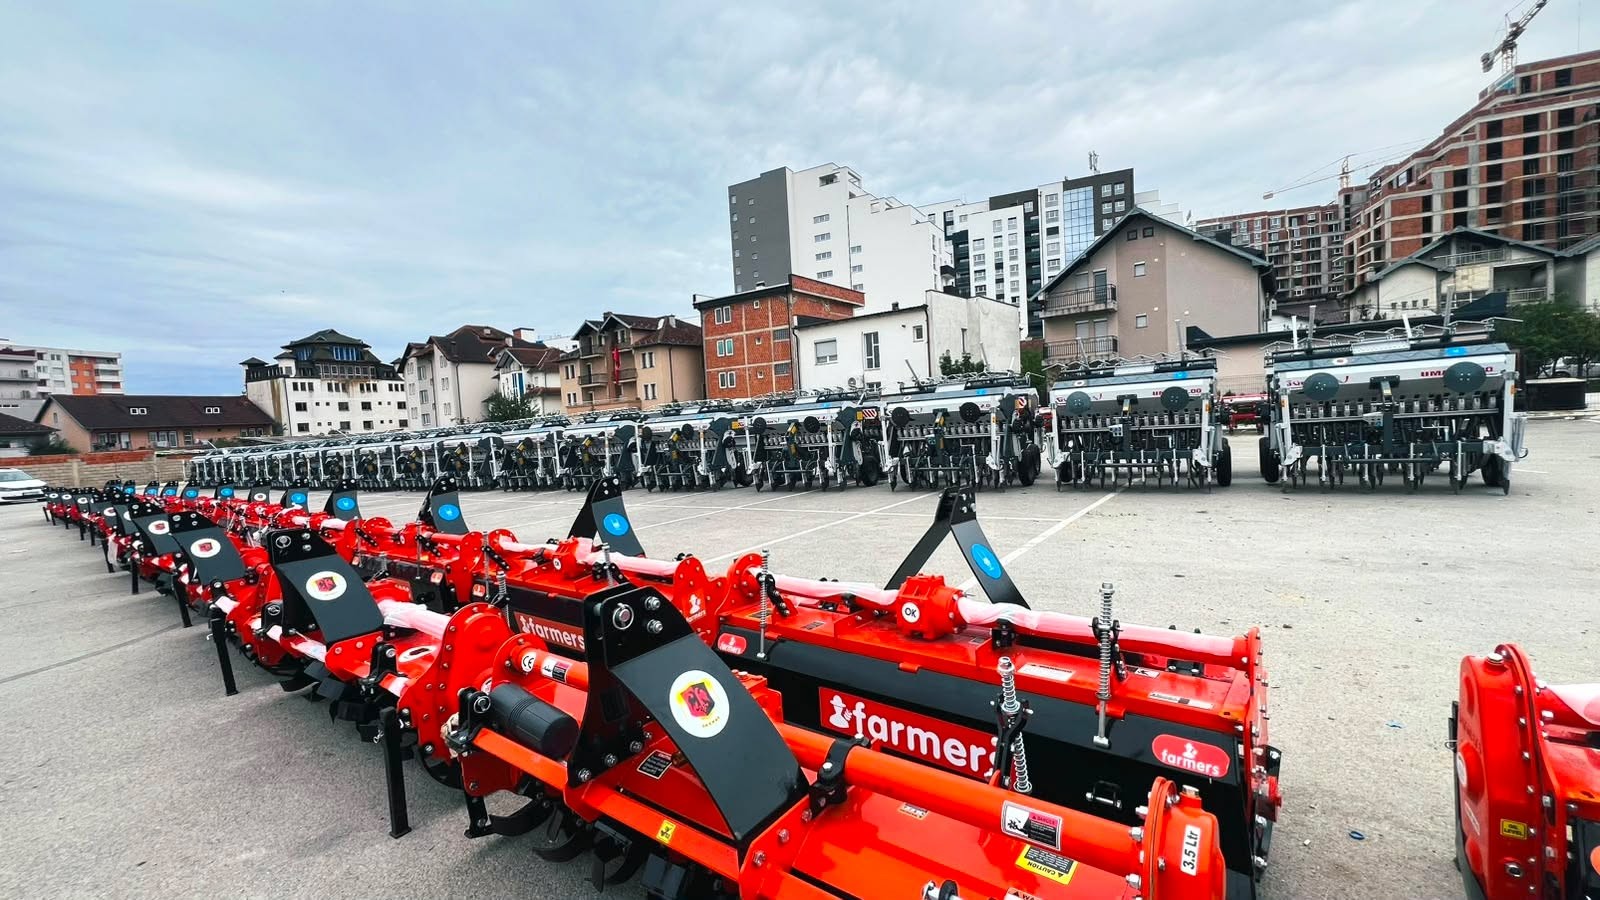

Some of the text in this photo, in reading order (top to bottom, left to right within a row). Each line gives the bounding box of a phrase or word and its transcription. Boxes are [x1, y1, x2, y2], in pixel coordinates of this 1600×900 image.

[528, 617, 585, 650] farmers
[1161, 749, 1220, 776] farmers
[1183, 830, 1199, 870] 3.5 Ltr
[1027, 861, 1056, 876] CAUTION
